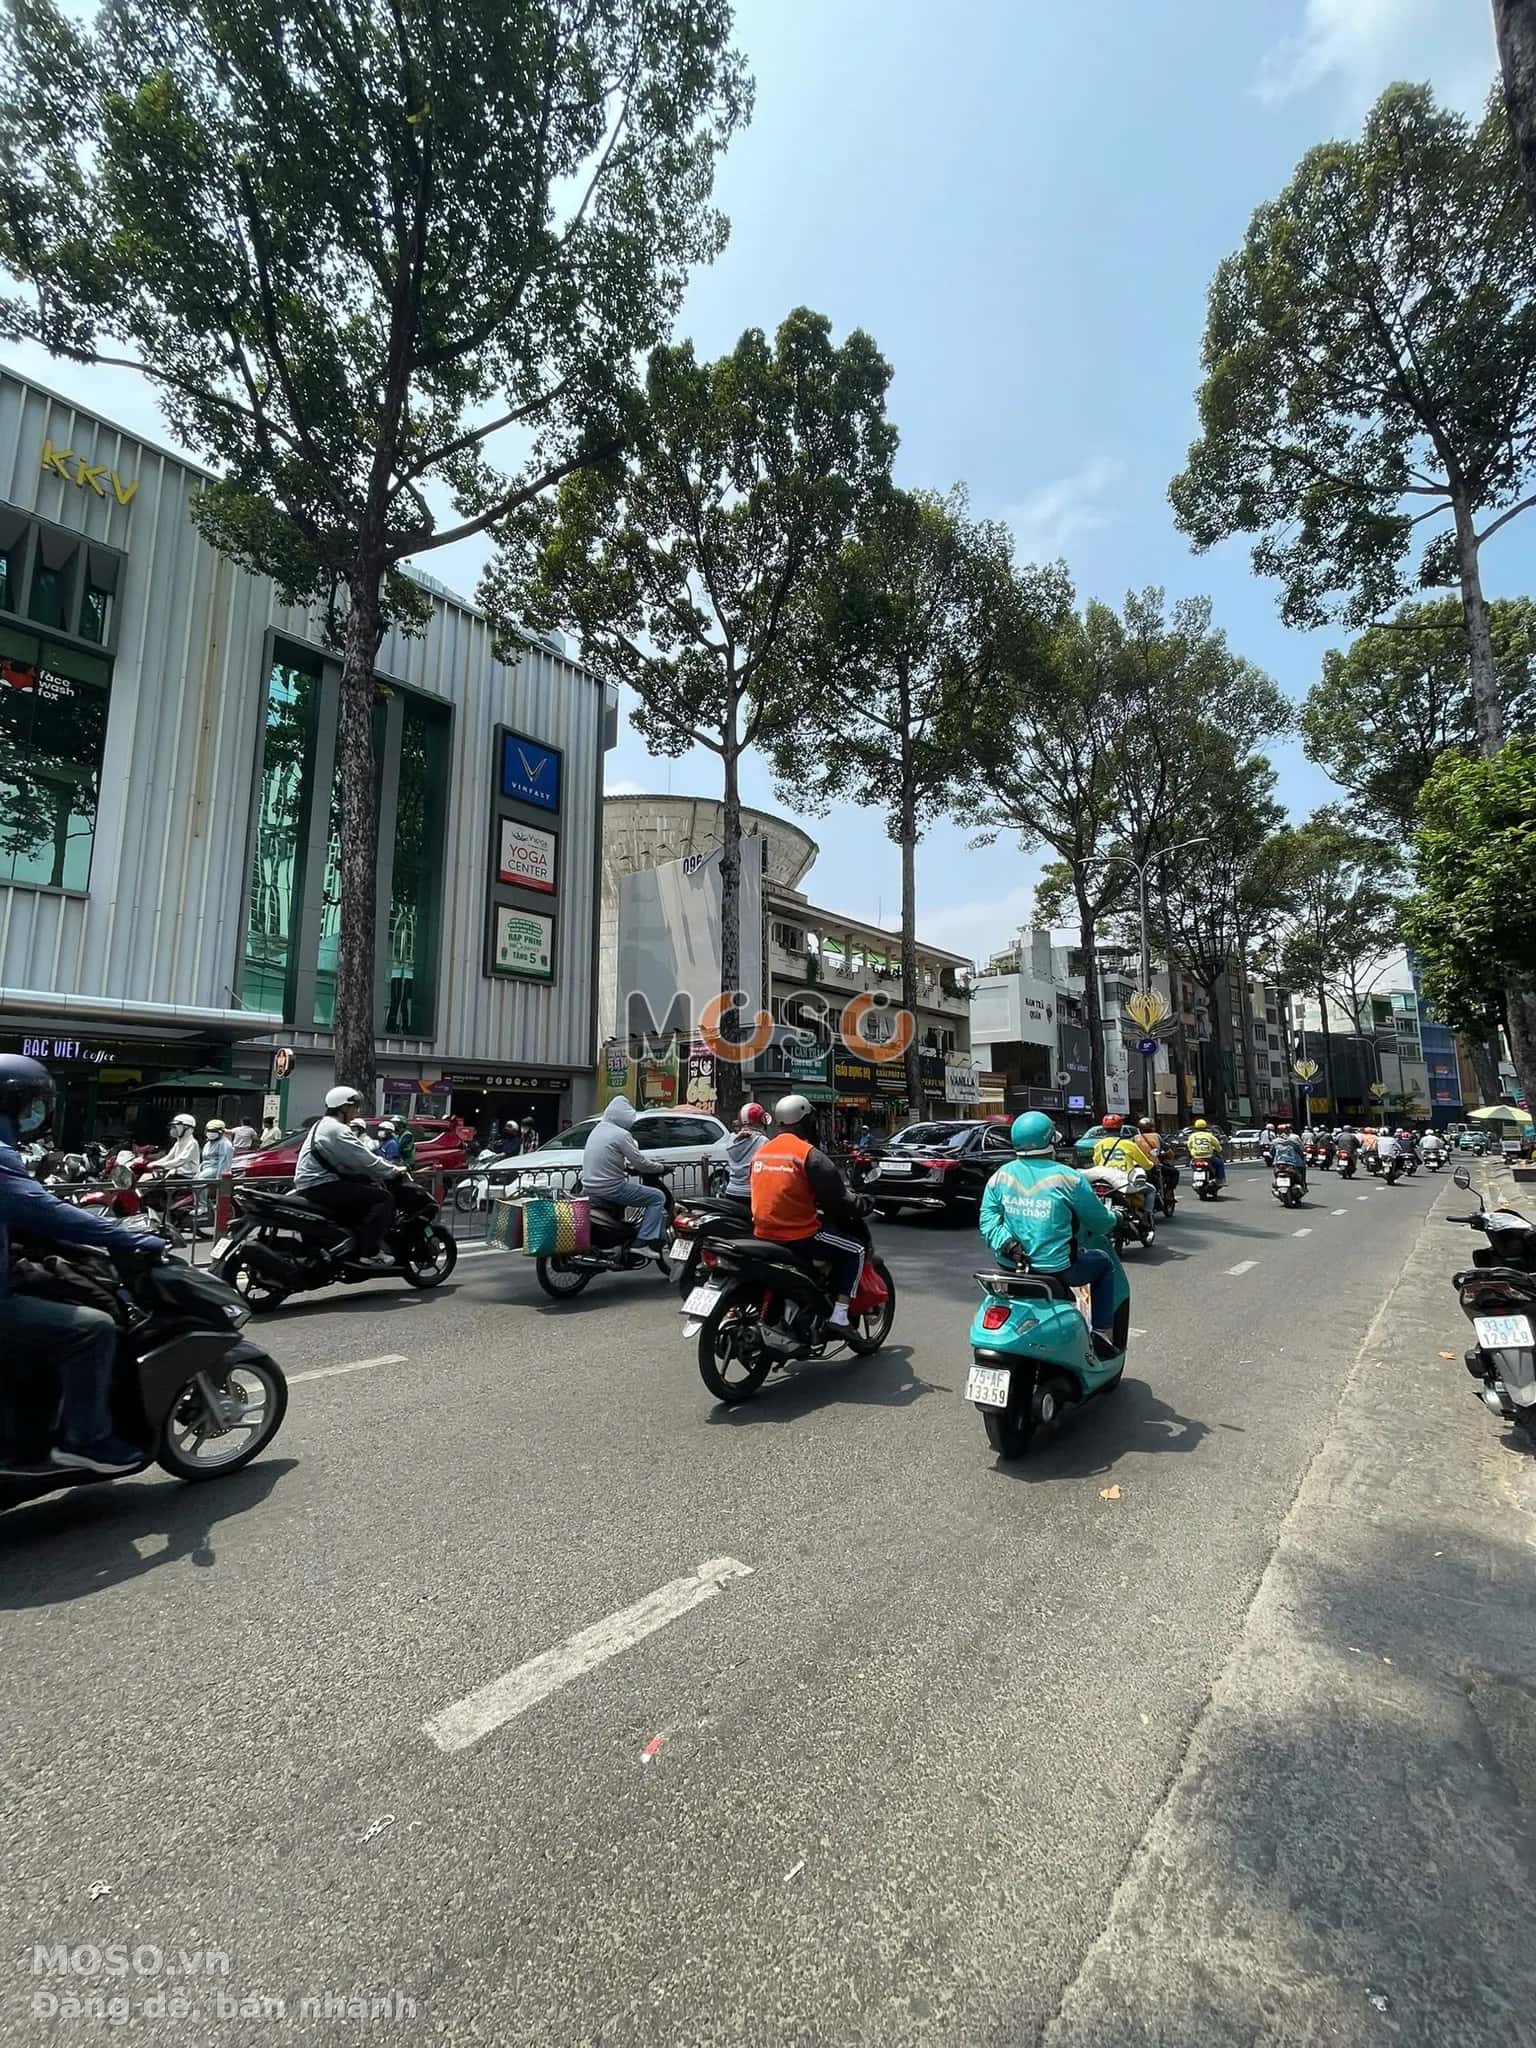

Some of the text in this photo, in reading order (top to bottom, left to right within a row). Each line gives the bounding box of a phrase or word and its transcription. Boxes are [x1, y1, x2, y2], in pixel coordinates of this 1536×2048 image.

[42, 439, 139, 505] KKV
[40, 670, 71, 687] face
[38, 687, 59, 701] fox
[39, 680, 75, 697] wash
[511, 781, 551, 800] VINFAST
[509, 844, 548, 867] YOGA
[507, 859, 548, 879] CENTER
[529, 952, 537, 964] 5
[1101, 1144, 1126, 1161] be
